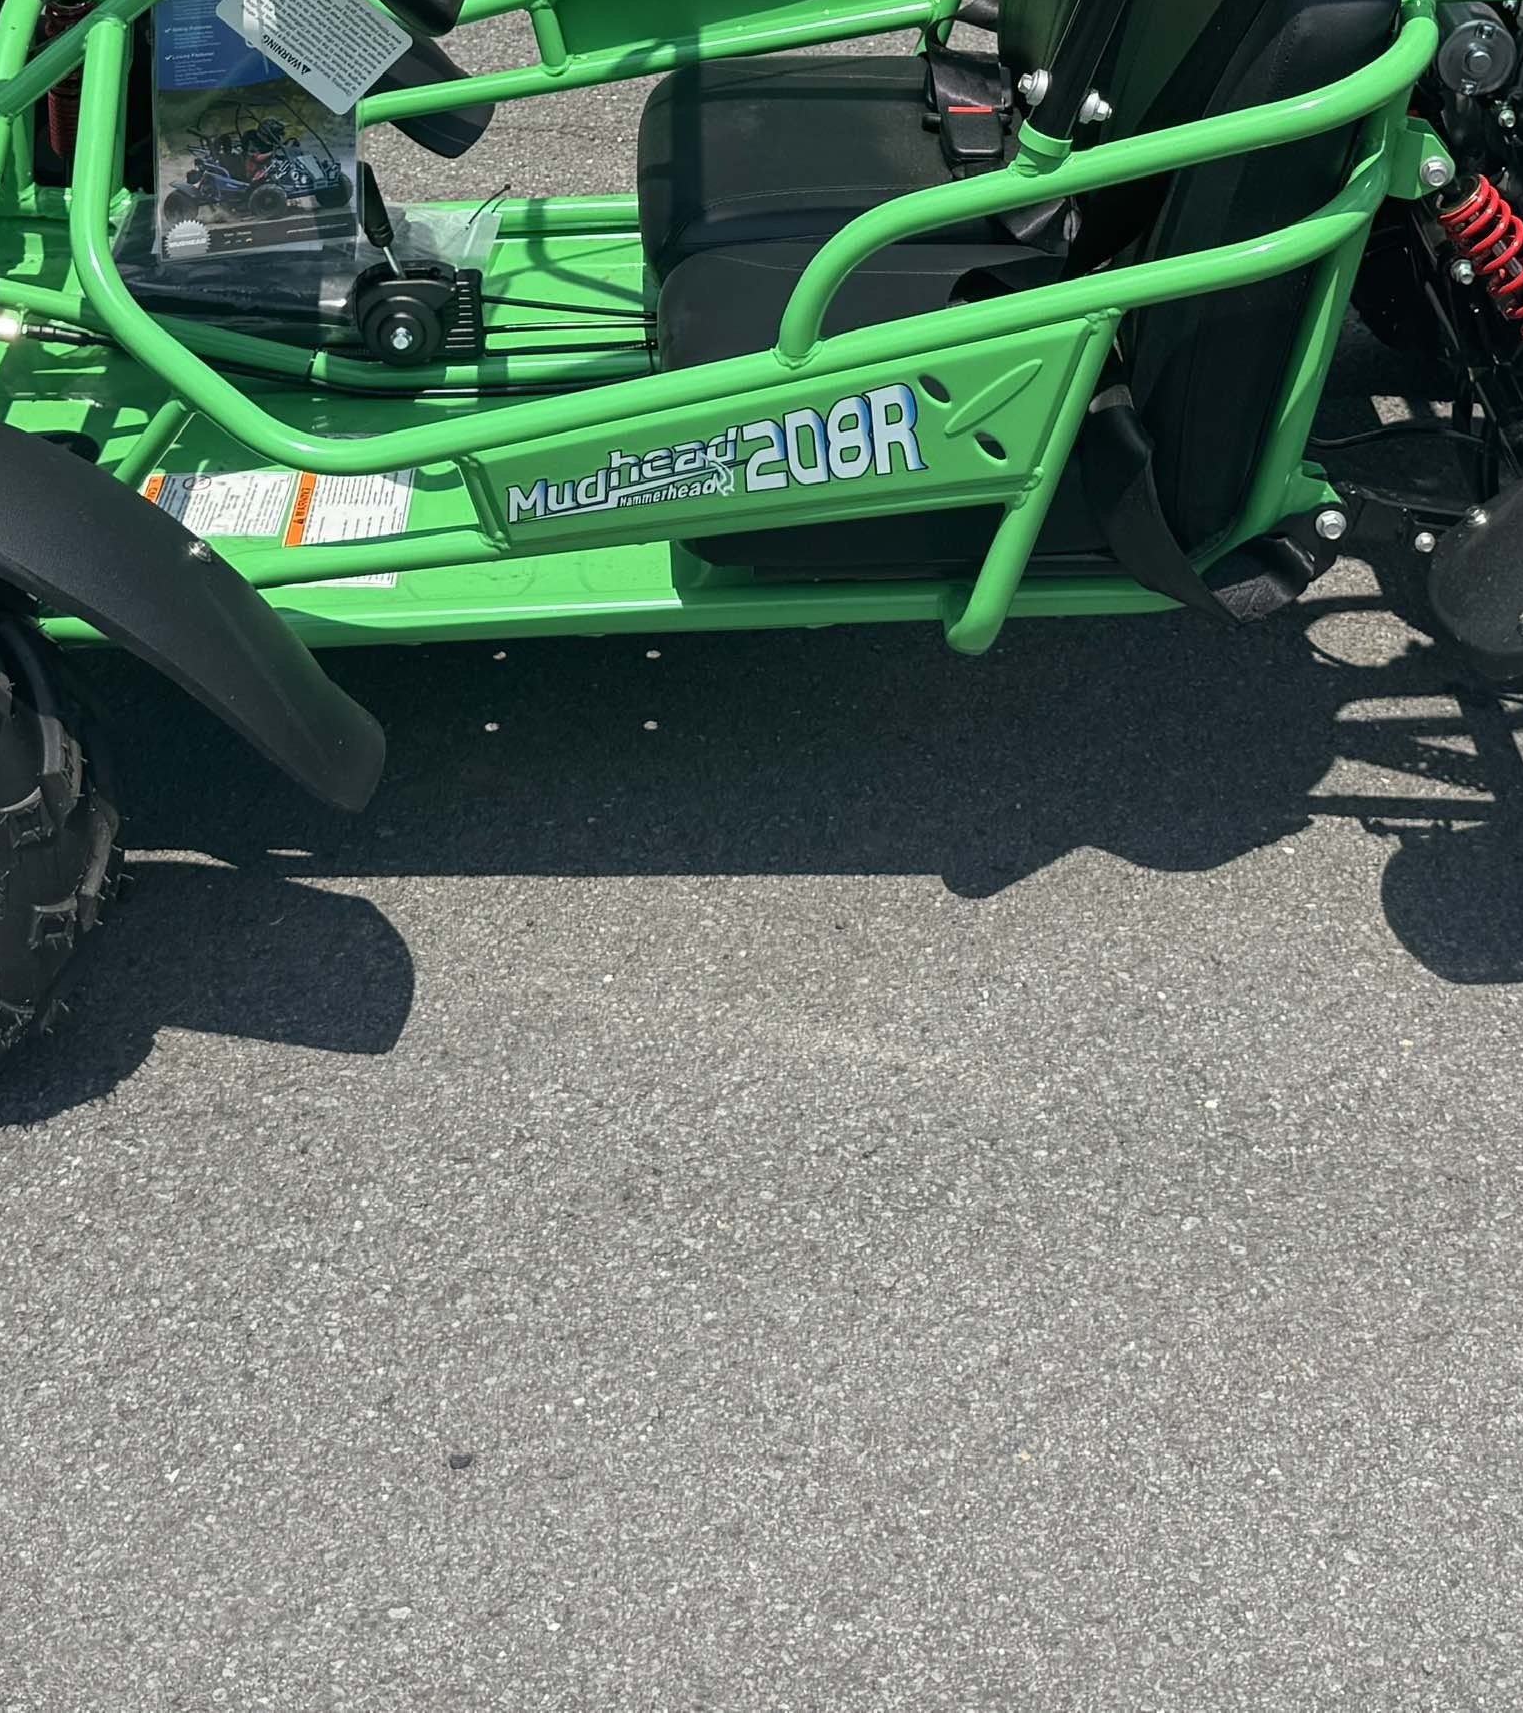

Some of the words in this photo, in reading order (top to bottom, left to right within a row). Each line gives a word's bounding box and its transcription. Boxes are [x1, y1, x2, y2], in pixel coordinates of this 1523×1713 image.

[262, 34, 302, 70] WARNING
[507, 425, 739, 524] Mudhead
[741, 383, 928, 493] 208R
[619, 472, 718, 509] Hammerhead
